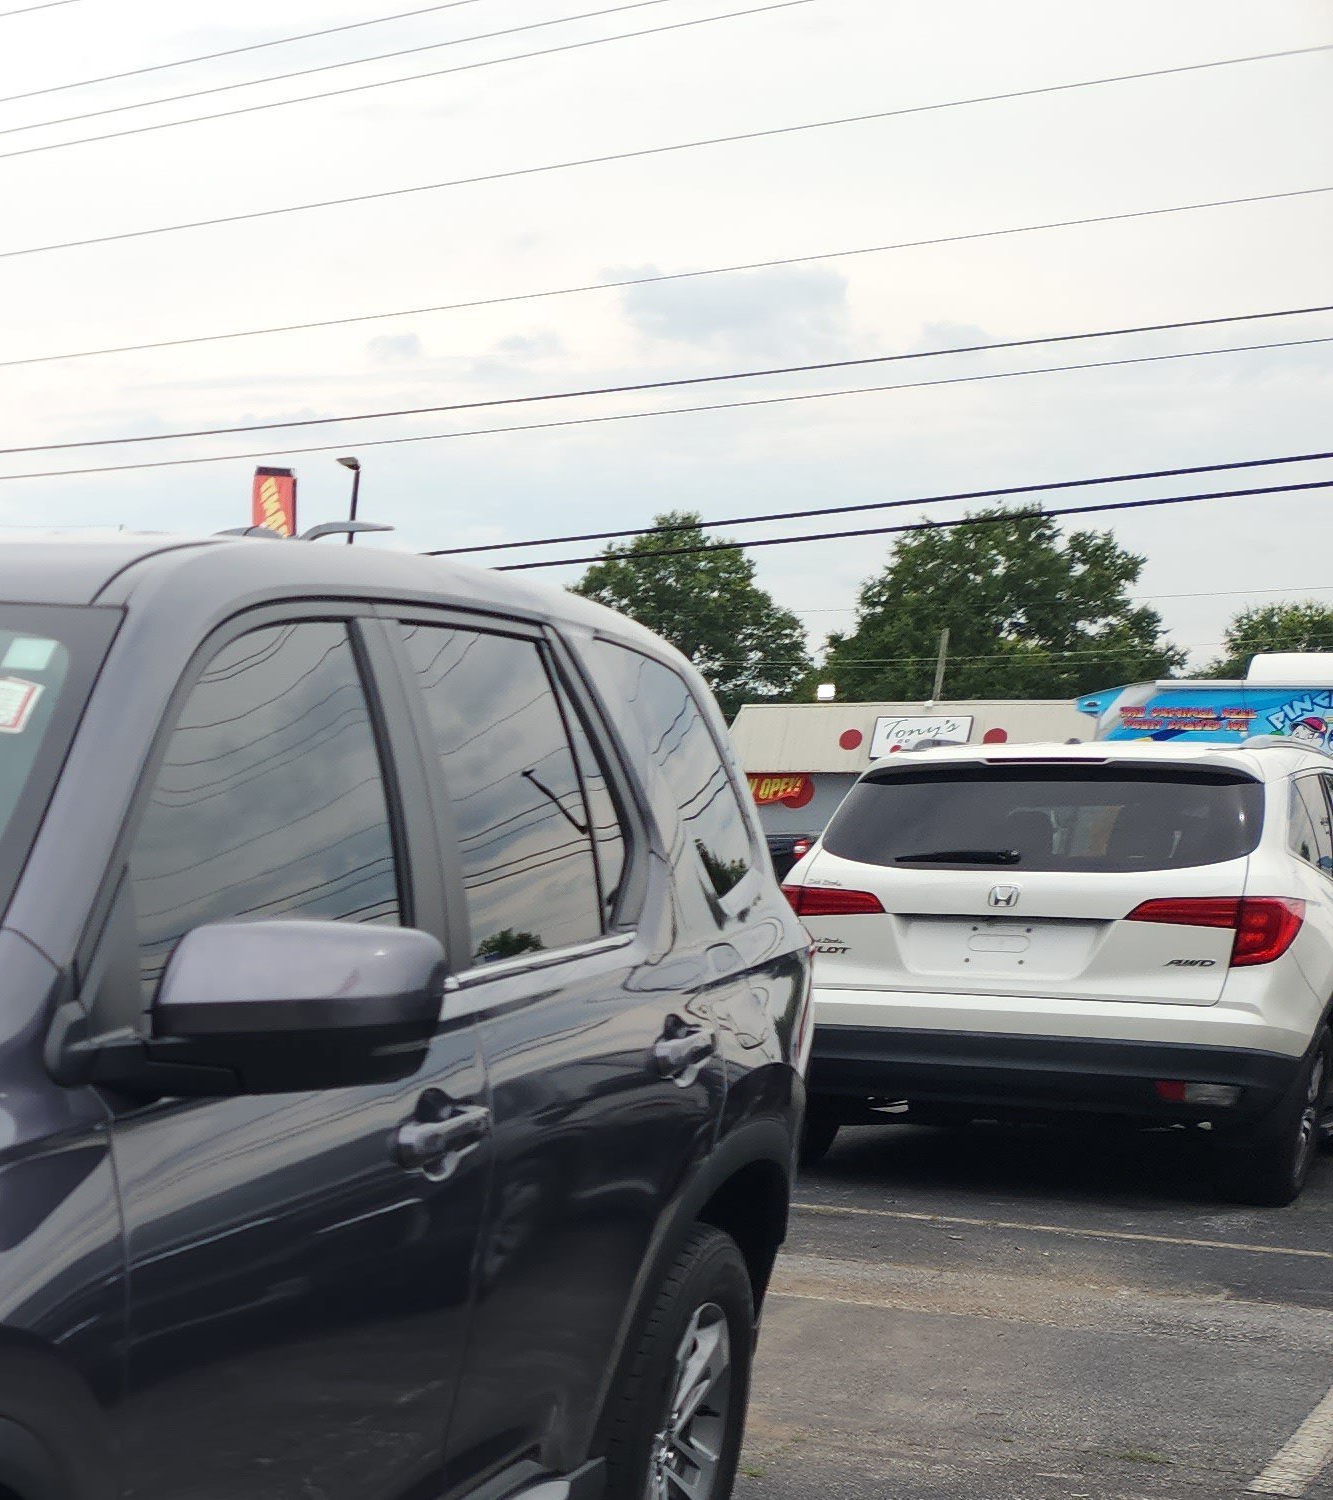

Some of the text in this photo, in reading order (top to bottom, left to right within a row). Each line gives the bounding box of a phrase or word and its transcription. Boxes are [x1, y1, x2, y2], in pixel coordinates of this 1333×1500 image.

[1265, 690, 1333, 730] PING
[884, 719, 961, 739] Tony's
[816, 945, 852, 954] LOT
[1162, 959, 1217, 967] AWD
